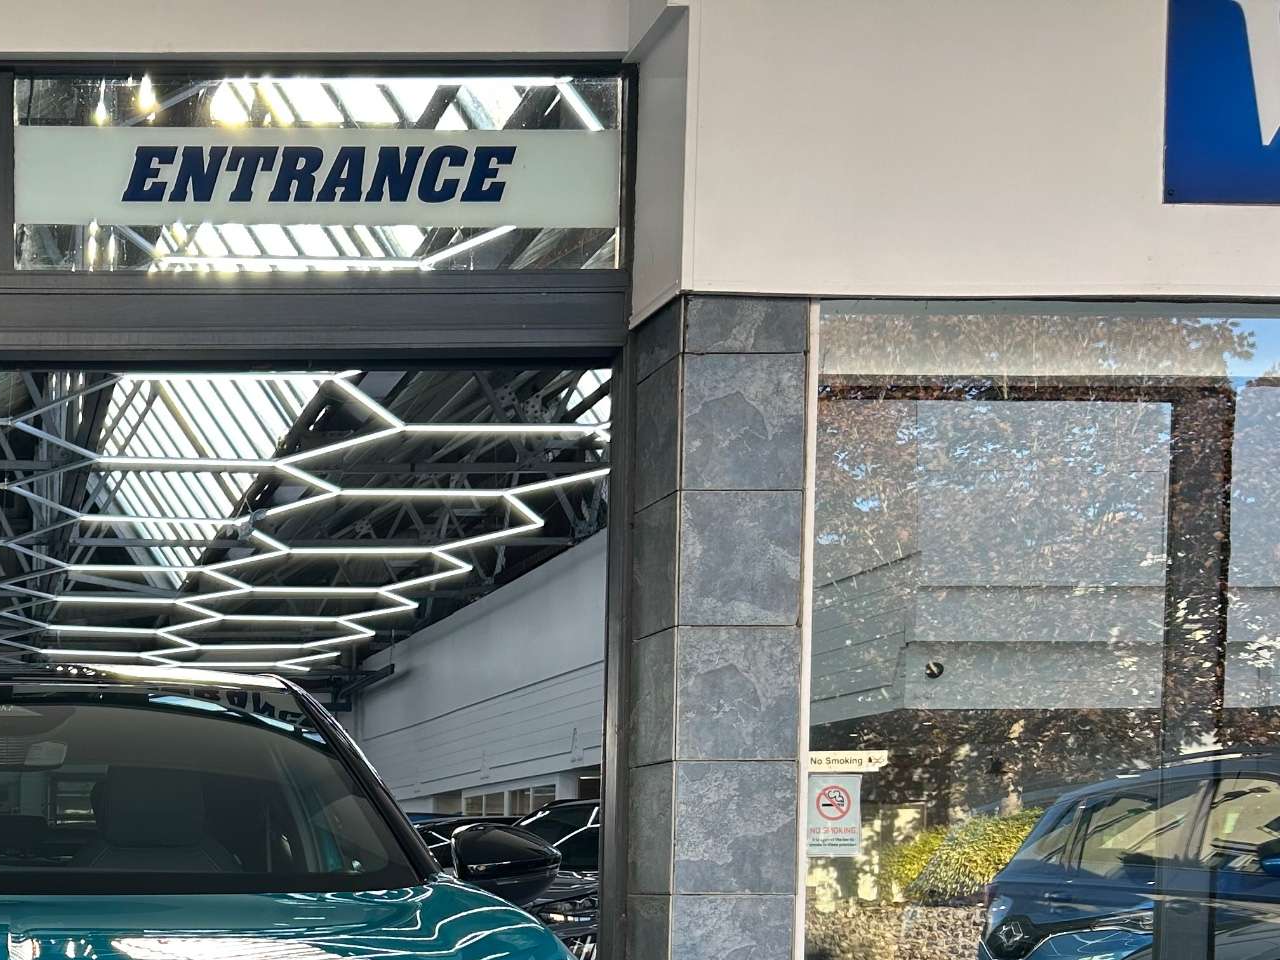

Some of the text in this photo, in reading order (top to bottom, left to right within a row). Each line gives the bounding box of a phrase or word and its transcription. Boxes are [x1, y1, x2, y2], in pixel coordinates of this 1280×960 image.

[121, 145, 518, 204] ENTRANCE
[810, 756, 863, 766] No Smoking
